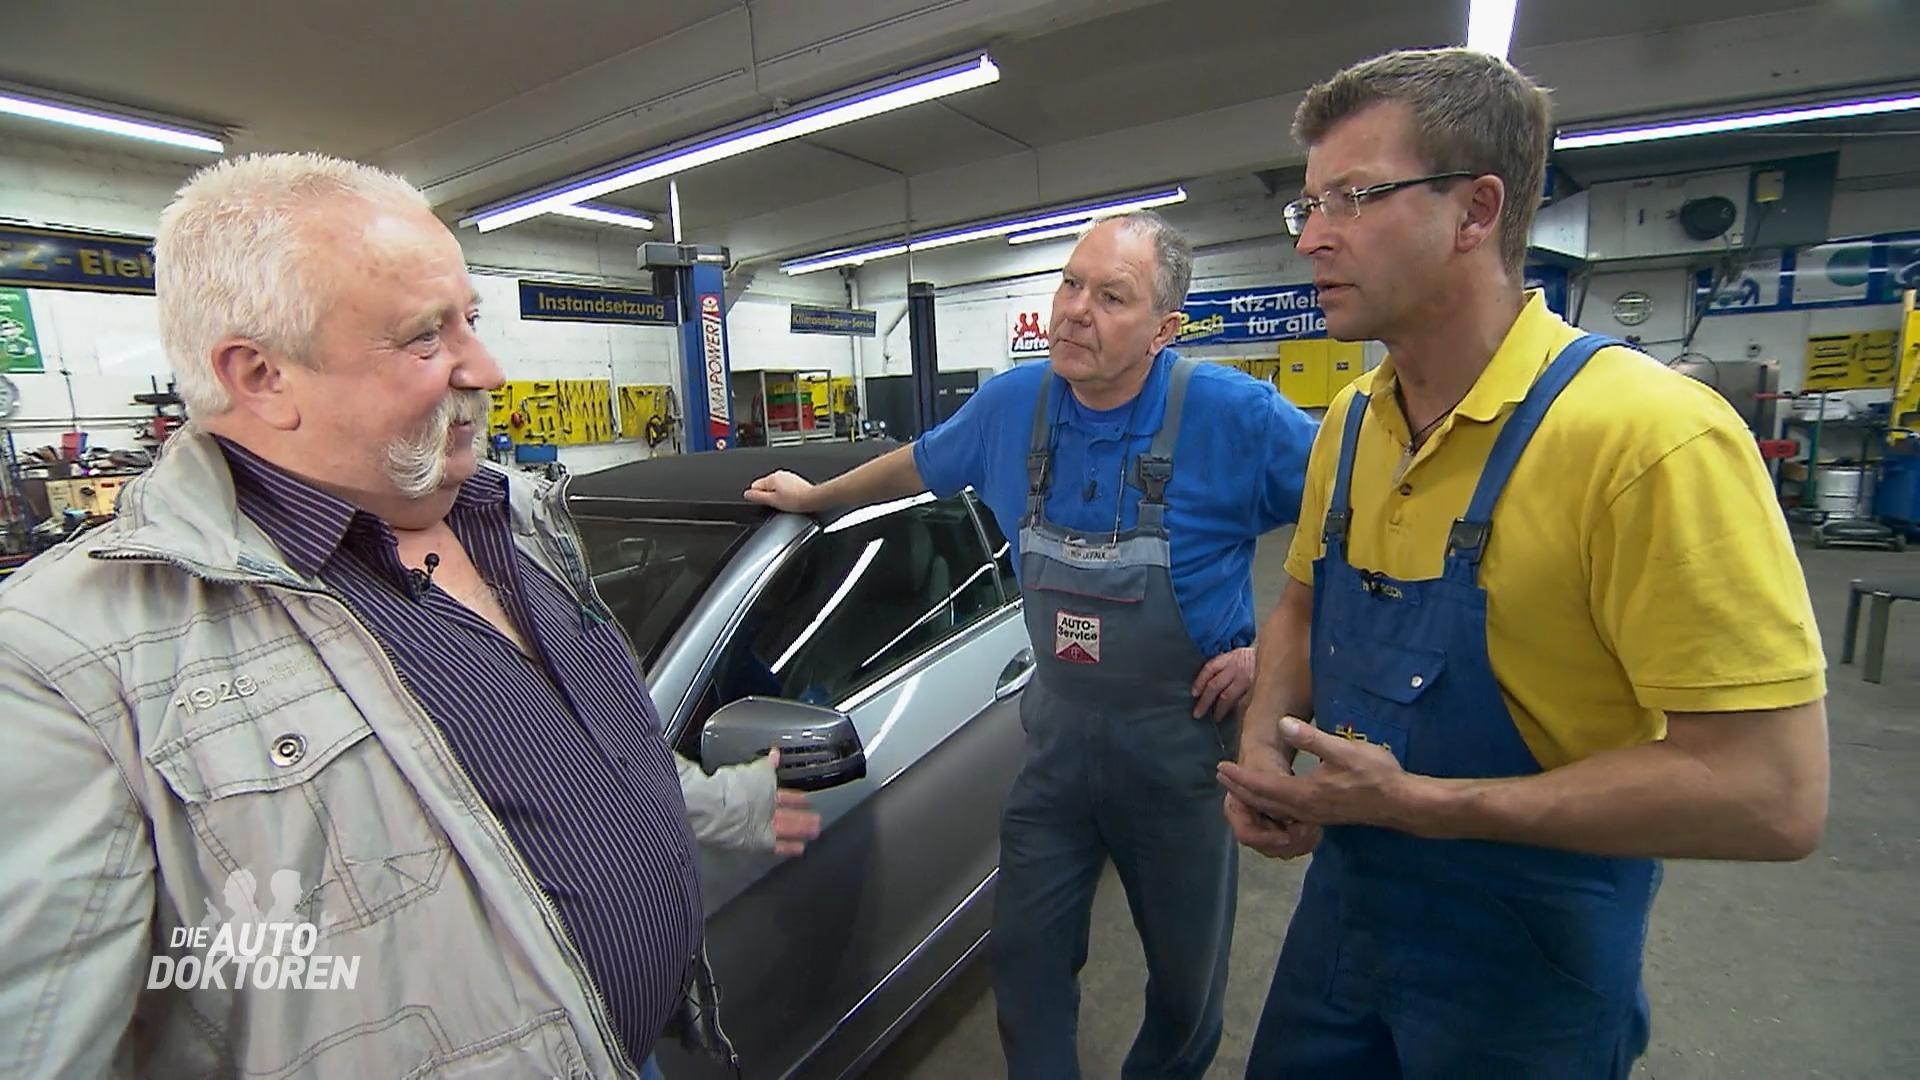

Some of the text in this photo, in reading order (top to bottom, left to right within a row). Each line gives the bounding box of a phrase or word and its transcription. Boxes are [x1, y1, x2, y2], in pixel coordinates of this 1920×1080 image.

[538, 292, 665, 320] Instandsetzung
[1231, 290, 1319, 314] Kfz-Mei
[1247, 316, 1280, 335] für
[1058, 625, 1098, 641] Service
[1062, 617, 1096, 630] AUTO-
[175, 674, 258, 717] 1928
